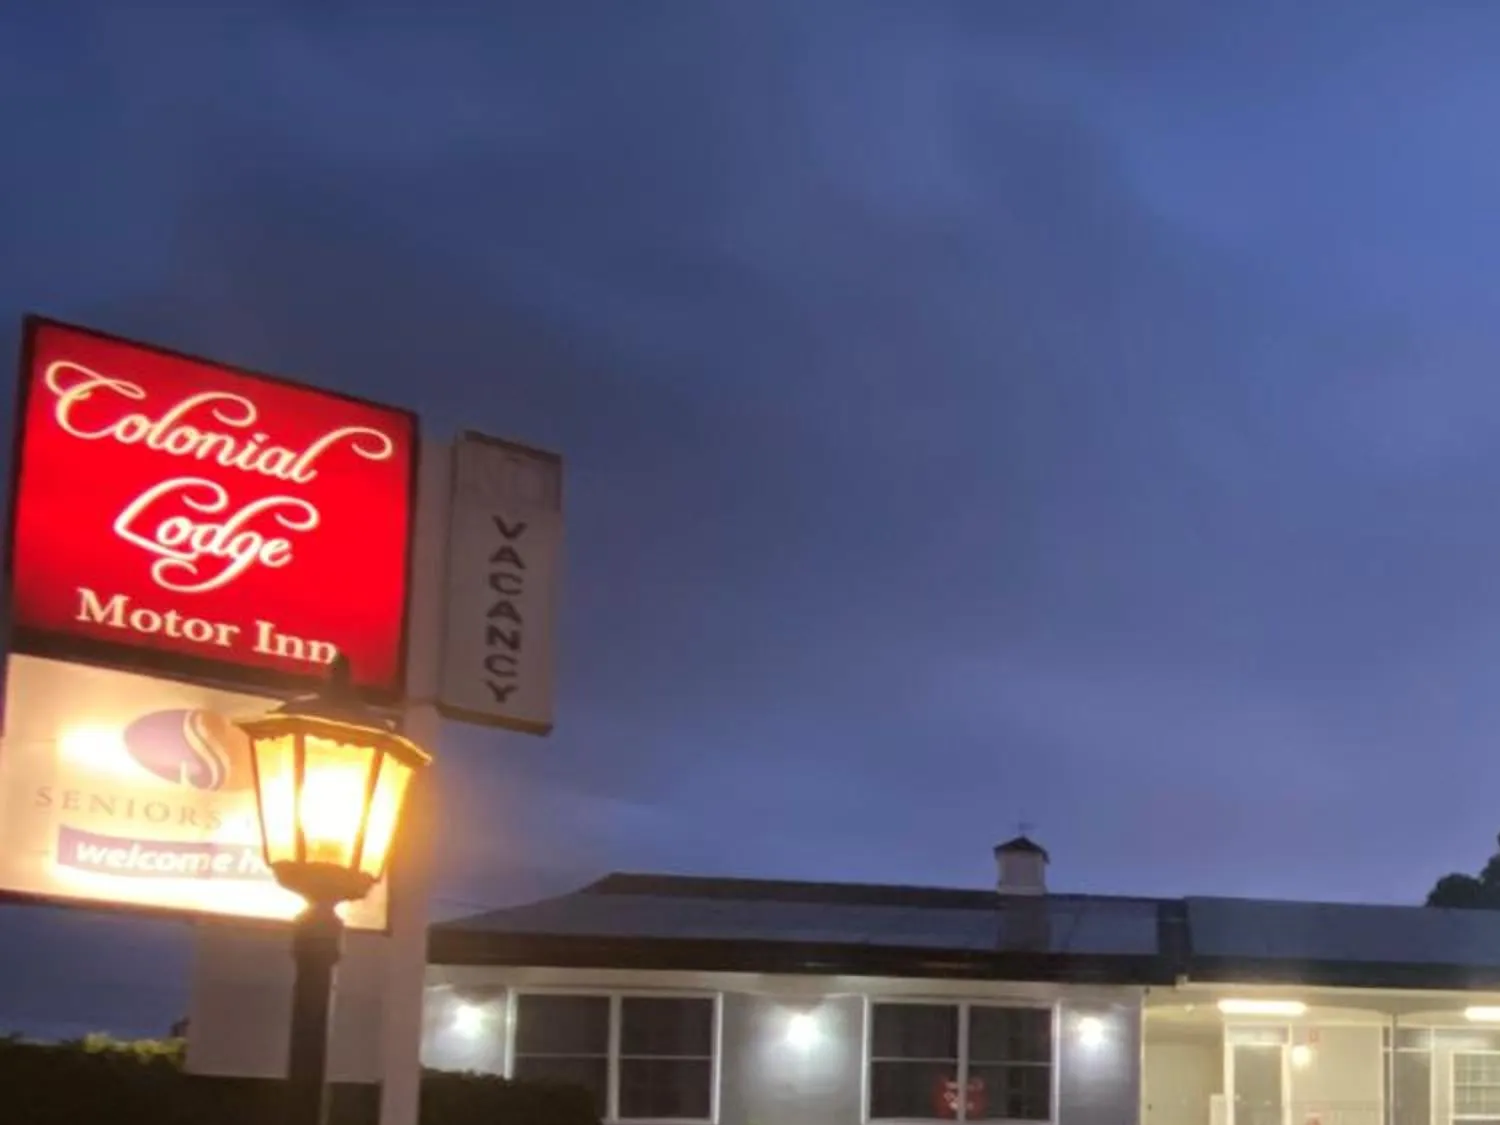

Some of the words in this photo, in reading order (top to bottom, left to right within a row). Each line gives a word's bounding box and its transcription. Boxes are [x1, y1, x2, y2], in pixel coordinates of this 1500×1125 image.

[45, 360, 394, 485] Colonial
[113, 476, 321, 593] Lodge
[75, 586, 241, 648] Motor
[252, 619, 338, 665] Inn
[482, 514, 527, 704] VACANCY
[34, 785, 223, 830] SENIORS
[76, 841, 232, 874] welcome
